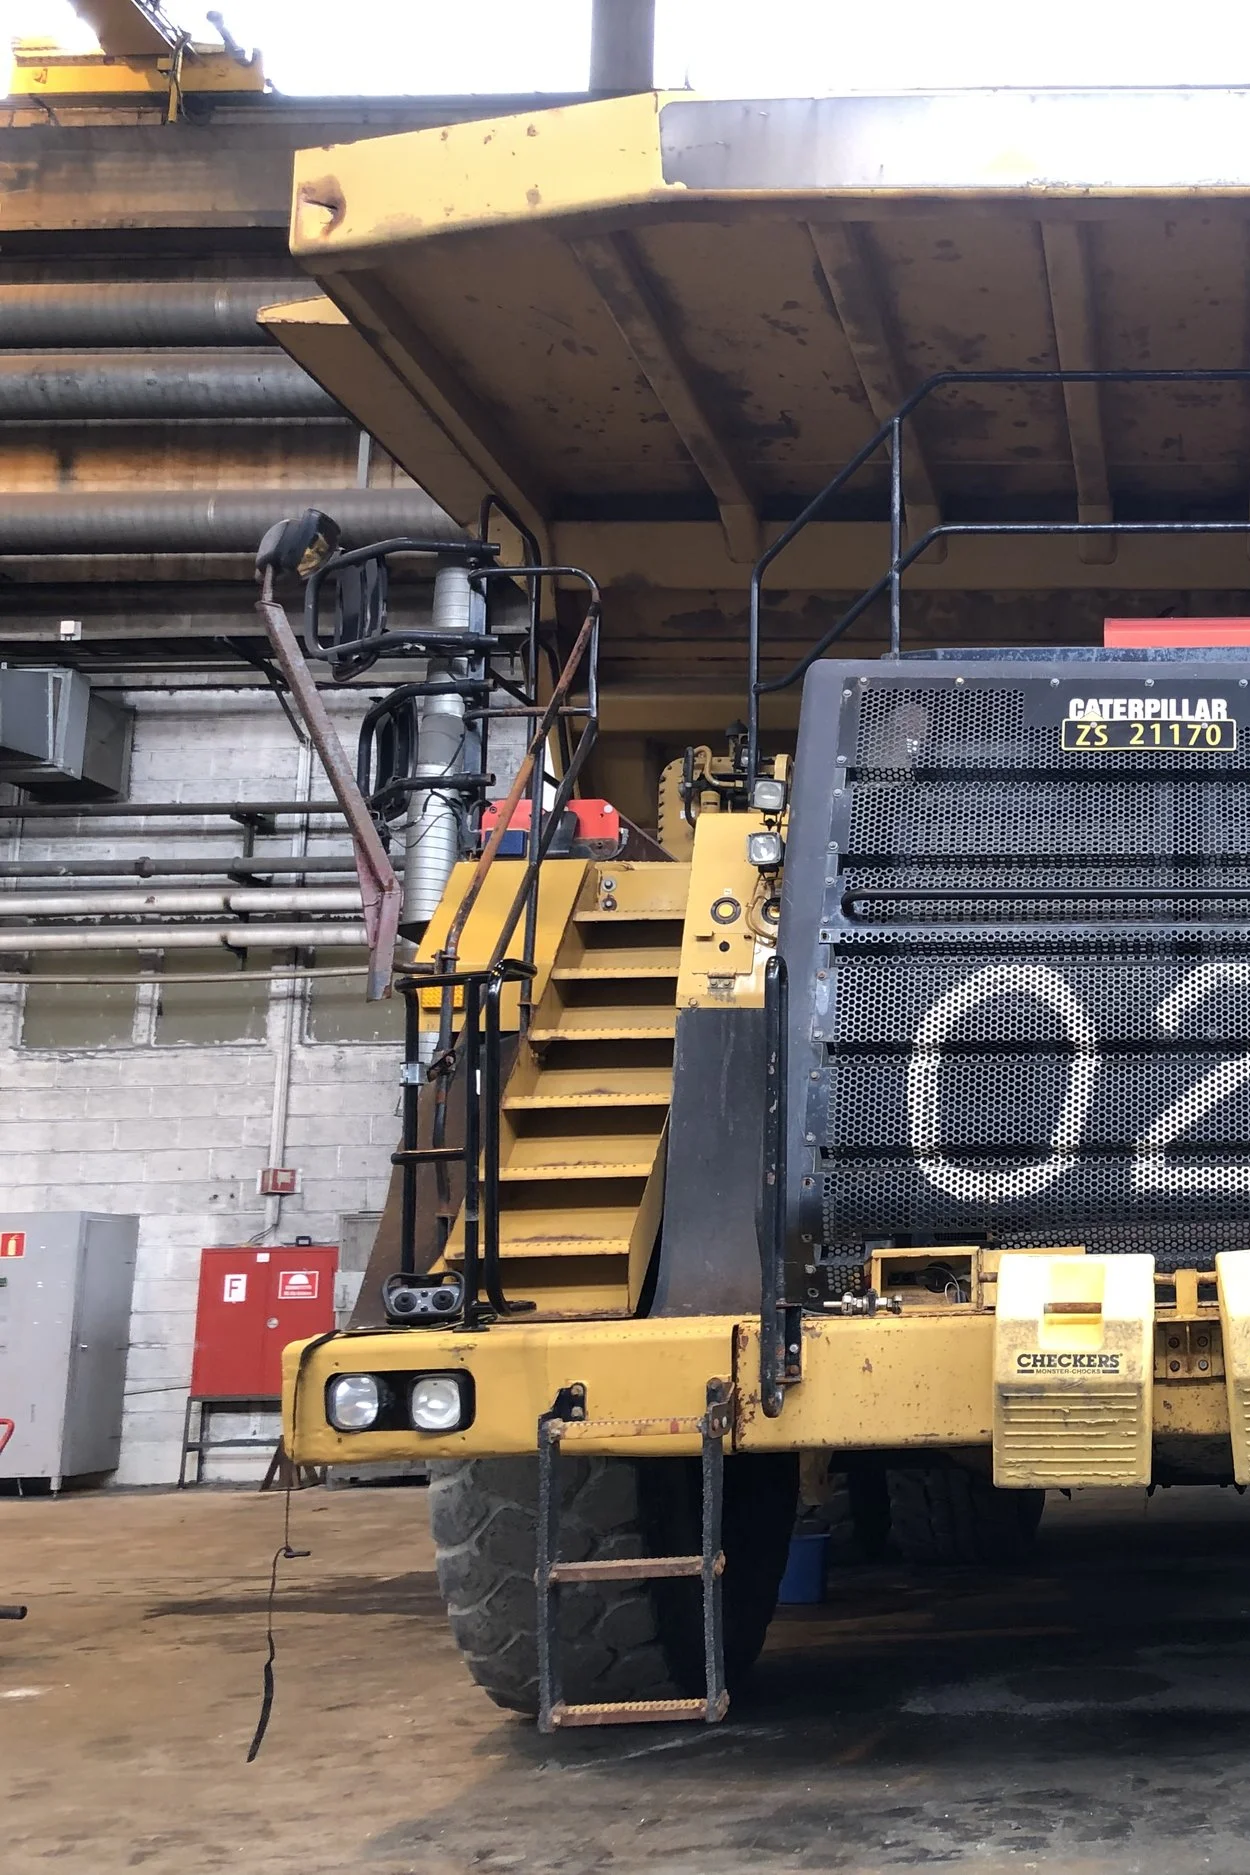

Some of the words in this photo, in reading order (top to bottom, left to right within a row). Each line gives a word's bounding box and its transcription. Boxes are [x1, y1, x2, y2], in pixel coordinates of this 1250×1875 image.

[1068, 698, 1229, 720] CATERPILLAR
[1075, 723, 1109, 747] ZS
[1129, 722, 1223, 747] 21170
[228, 1278, 242, 1299] F
[1017, 1353, 1121, 1368] CHECKERS
